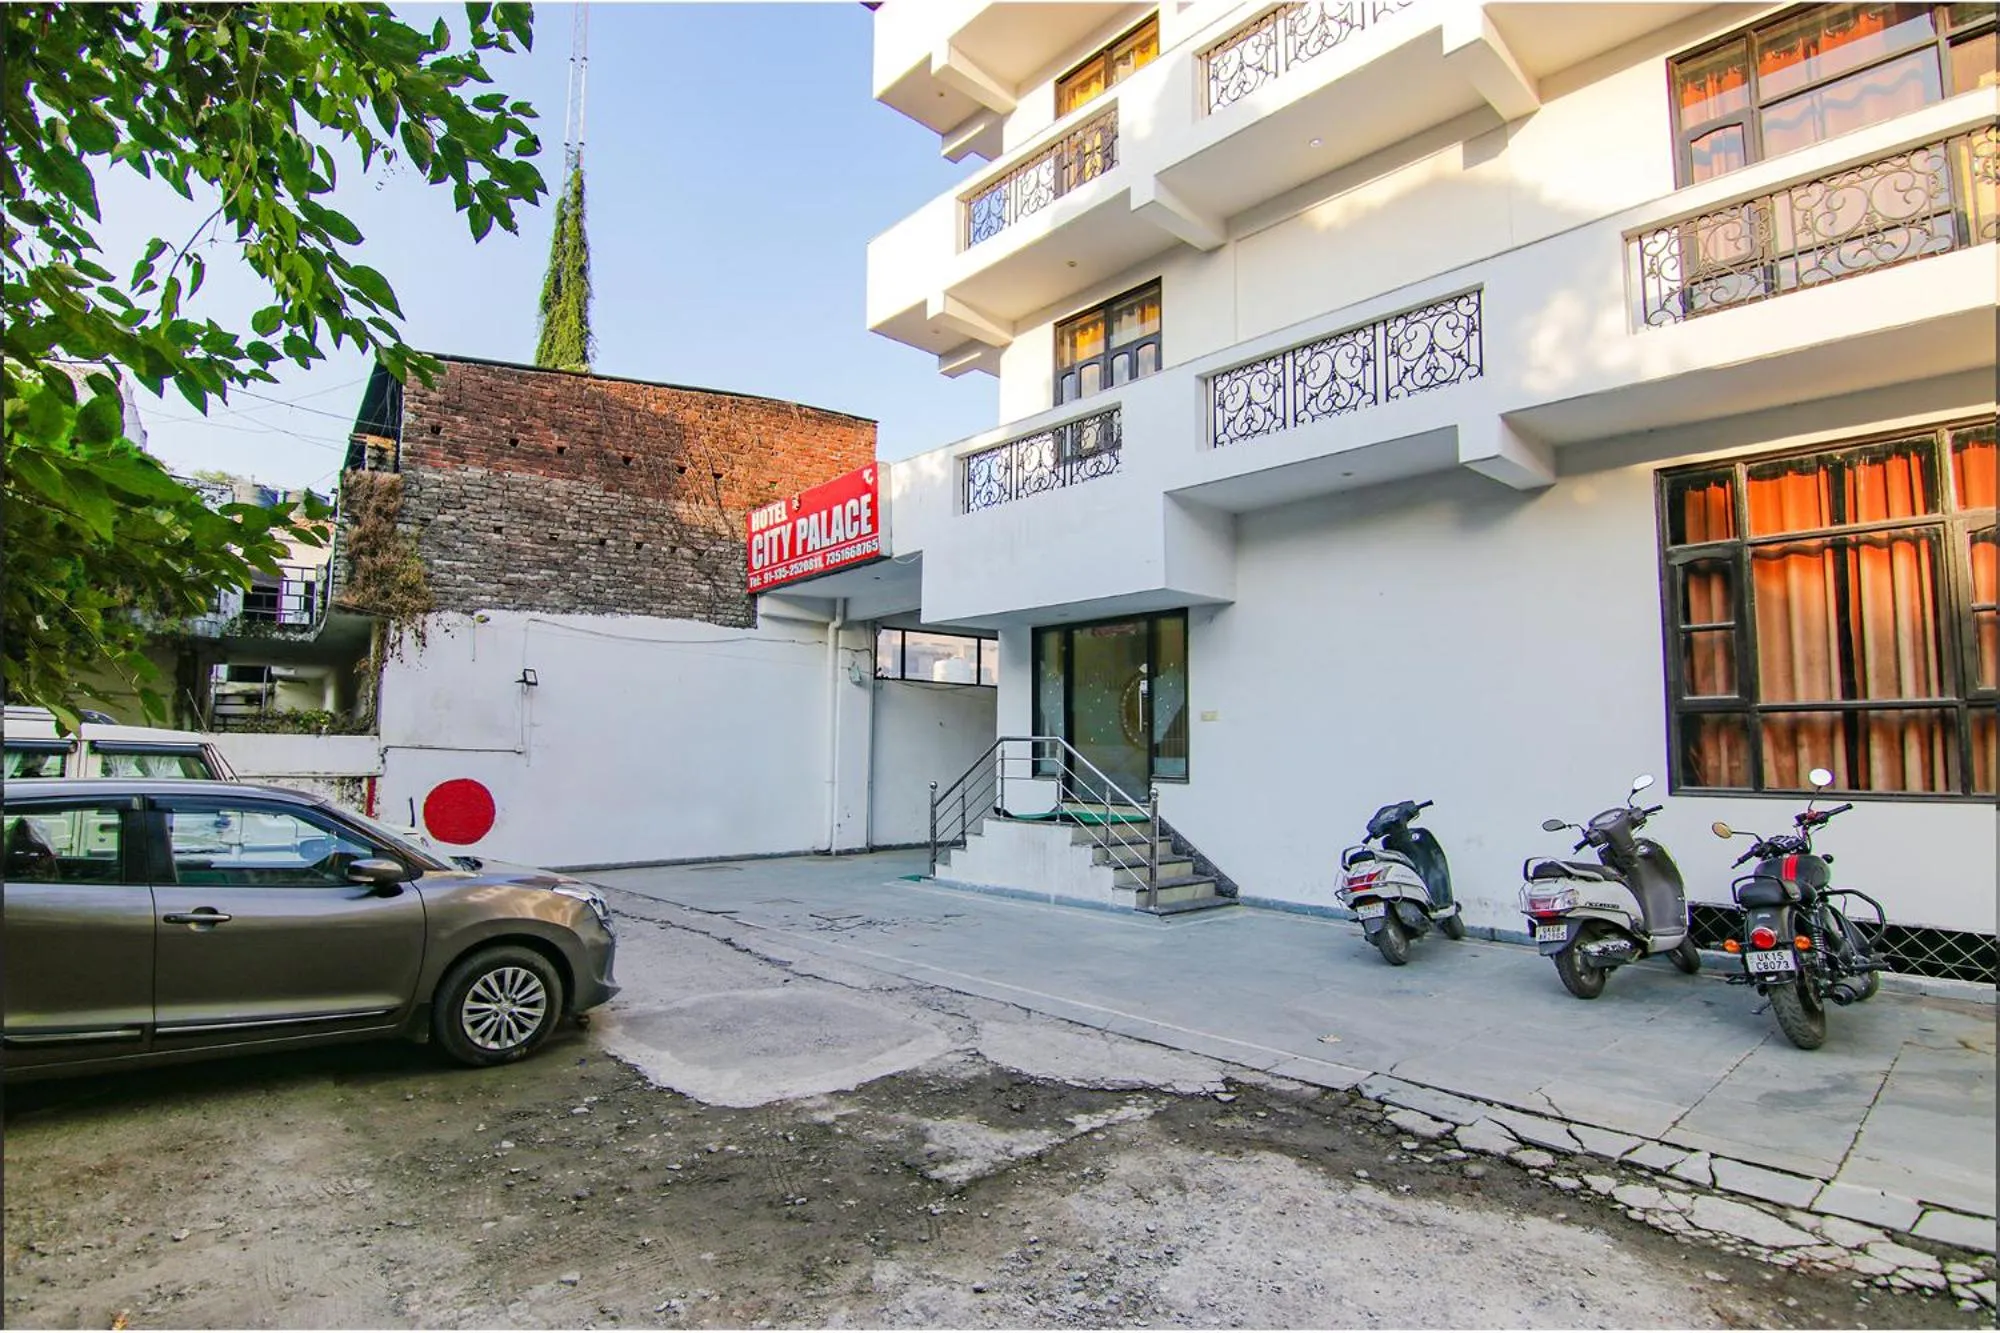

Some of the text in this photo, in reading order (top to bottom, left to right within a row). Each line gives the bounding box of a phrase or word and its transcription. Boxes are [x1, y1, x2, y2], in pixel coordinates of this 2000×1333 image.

[752, 501, 788, 532] HOTEL
[752, 494, 872, 570] CITY PALACE
